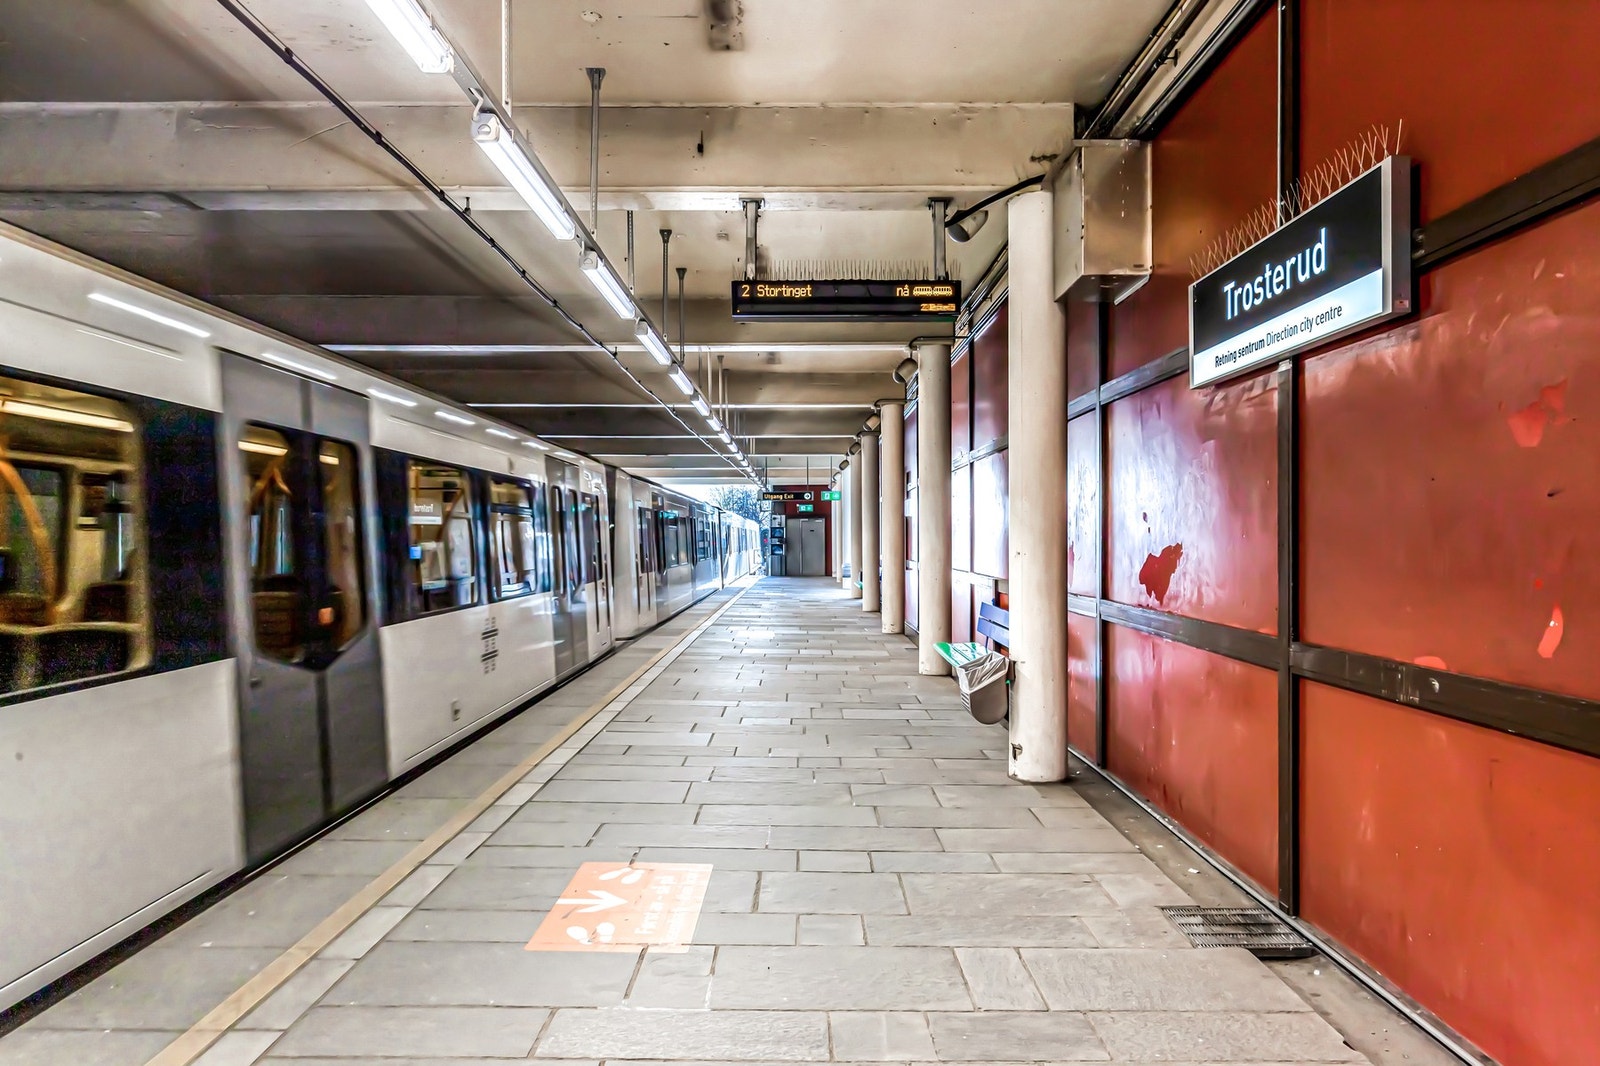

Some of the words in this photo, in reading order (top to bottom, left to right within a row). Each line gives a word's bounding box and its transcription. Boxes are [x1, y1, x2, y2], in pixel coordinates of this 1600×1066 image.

[741, 285, 750, 297] 2
[757, 284, 812, 298] Stortinget
[1223, 227, 1326, 320] Trosterud
[1215, 350, 1237, 368] Retning
[1238, 338, 1265, 358] sentrum
[1266, 324, 1298, 346] Direction
[1299, 316, 1314, 333] city
[1315, 305, 1342, 326] centre
